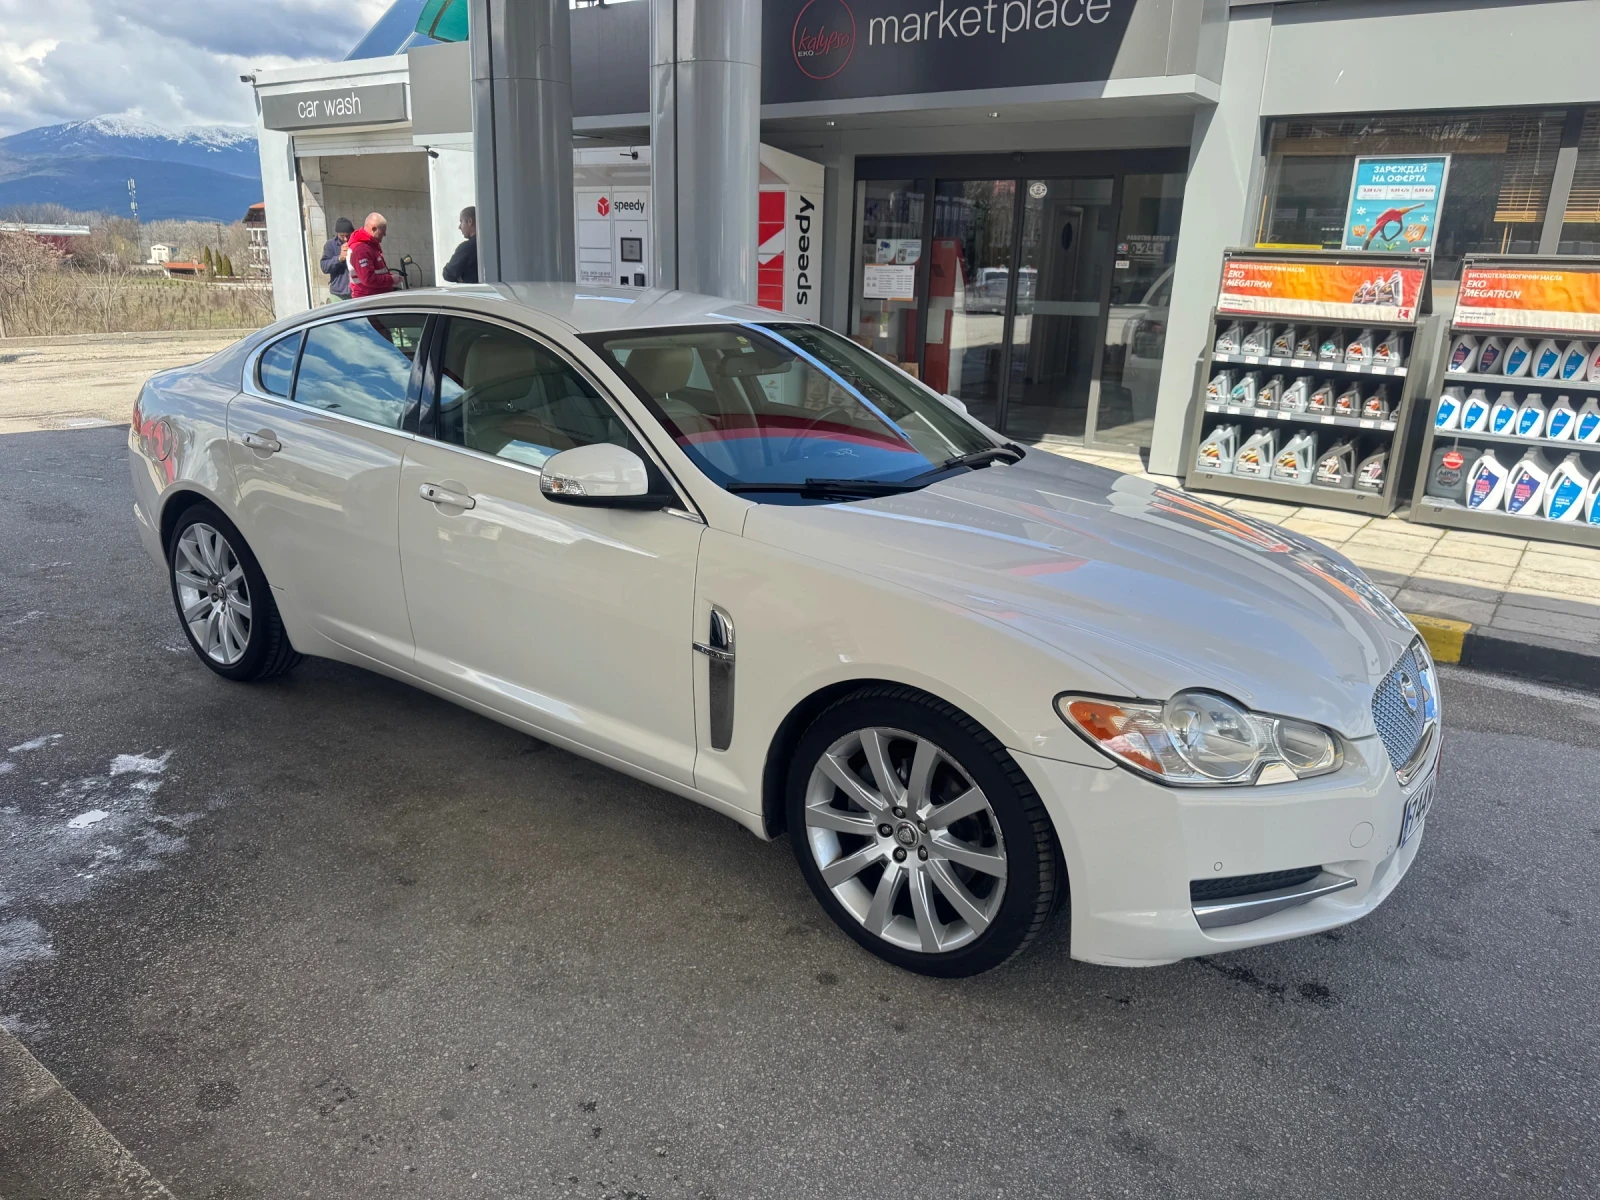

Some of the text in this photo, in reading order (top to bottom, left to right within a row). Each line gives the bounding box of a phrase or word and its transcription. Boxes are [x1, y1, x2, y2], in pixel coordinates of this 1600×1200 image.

[868, 0, 1112, 46] marketplace
[798, 26, 850, 56] kalypso
[298, 92, 361, 118] car wash
[1374, 164, 1427, 173] ЗАРЕЖДАЙ
[1371, 174, 1426, 183] НА ОФЕРТА
[614, 199, 644, 213] speedy
[795, 195, 815, 305] speedy
[1227, 269, 1245, 278] EKO
[1226, 279, 1272, 288] MEGATRON
[1465, 280, 1487, 288] EKO
[1464, 289, 1521, 298] MEGATRON
